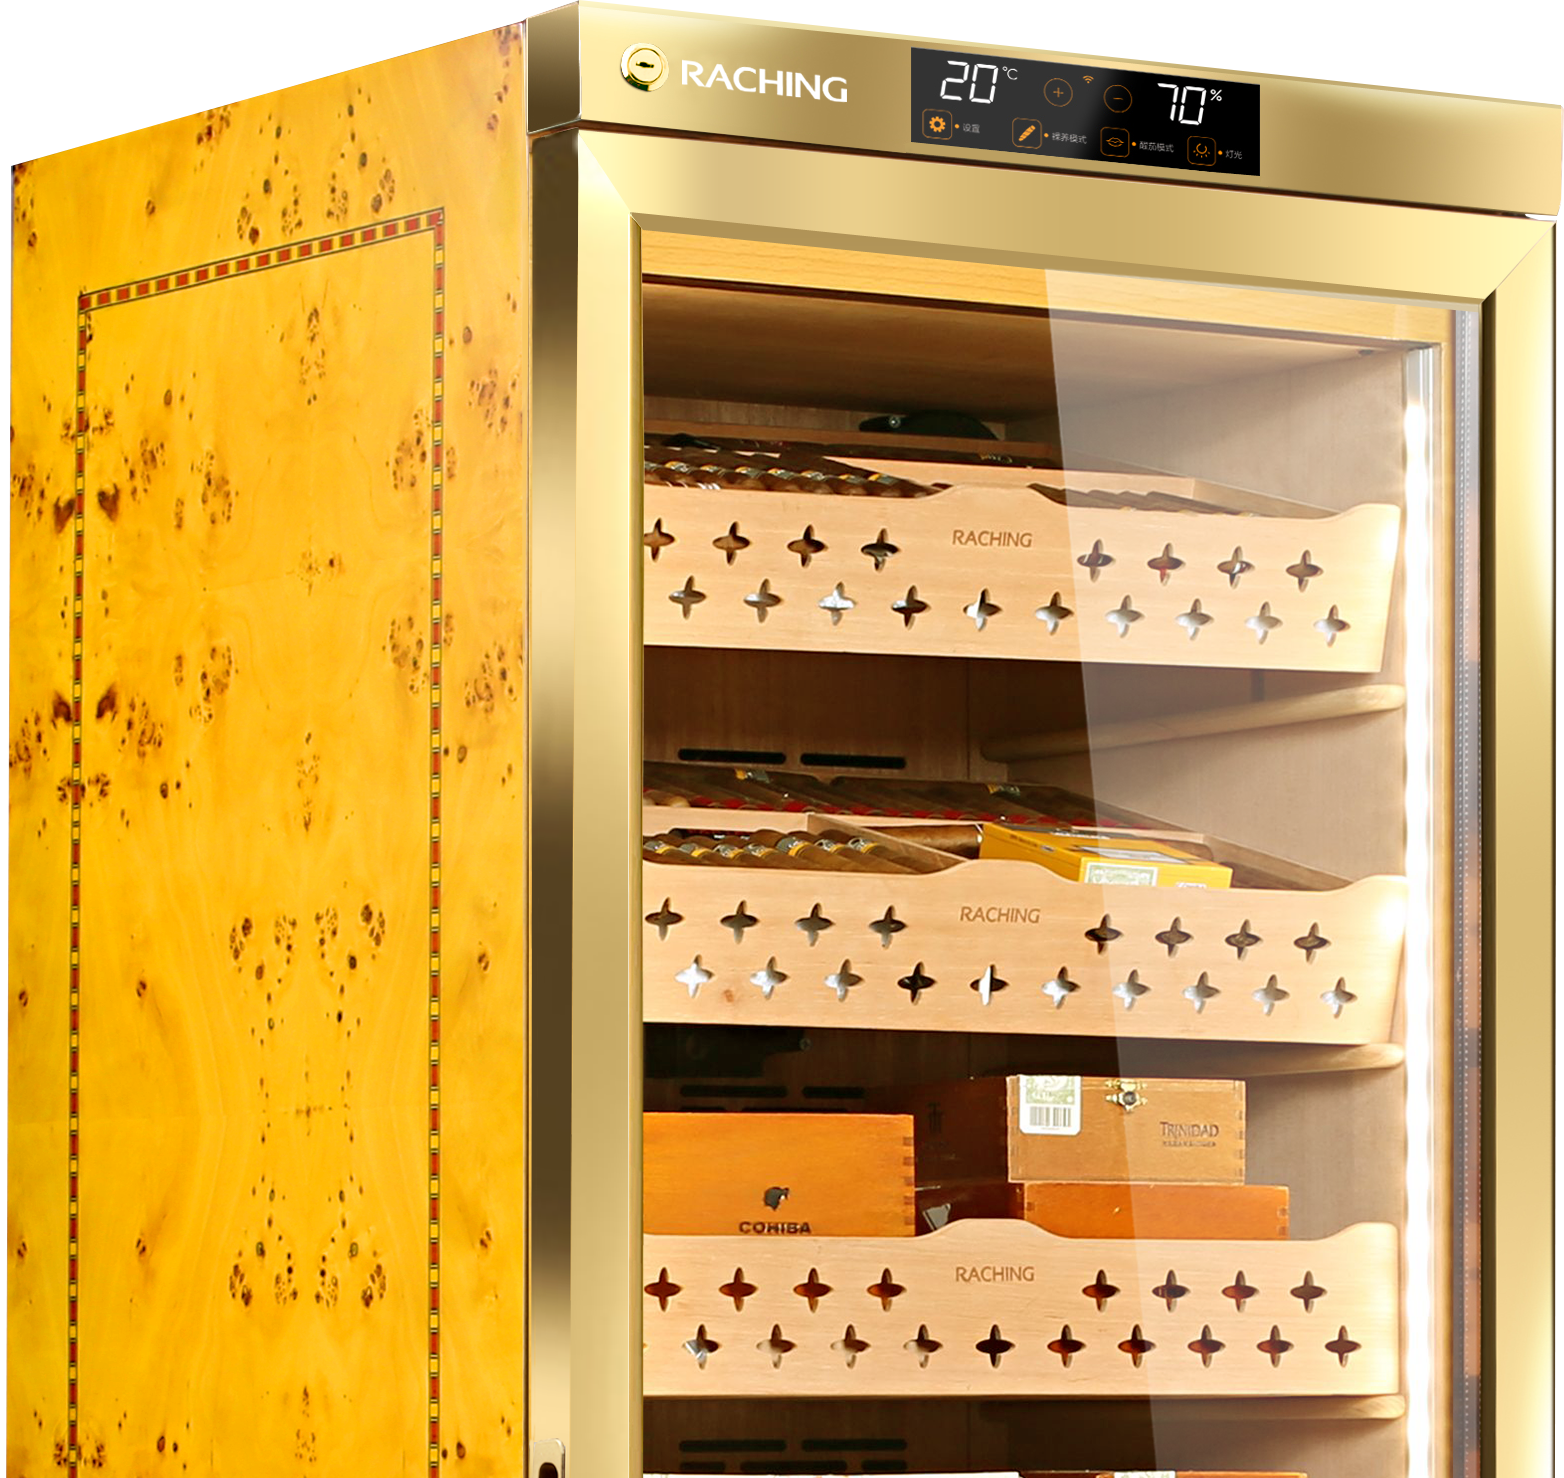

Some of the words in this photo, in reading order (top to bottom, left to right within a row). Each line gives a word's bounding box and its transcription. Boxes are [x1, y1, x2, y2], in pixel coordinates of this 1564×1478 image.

[681, 59, 848, 103] RACHING
[962, 123, 981, 134] 设置
[1225, 149, 1243, 160] 灯光
[952, 529, 1033, 548] RACHING
[960, 906, 1041, 924] RACHING
[1160, 1121, 1220, 1138] TRINIDAD
[739, 1221, 812, 1235] COHIBA
[955, 1266, 1035, 1283] RACHING
